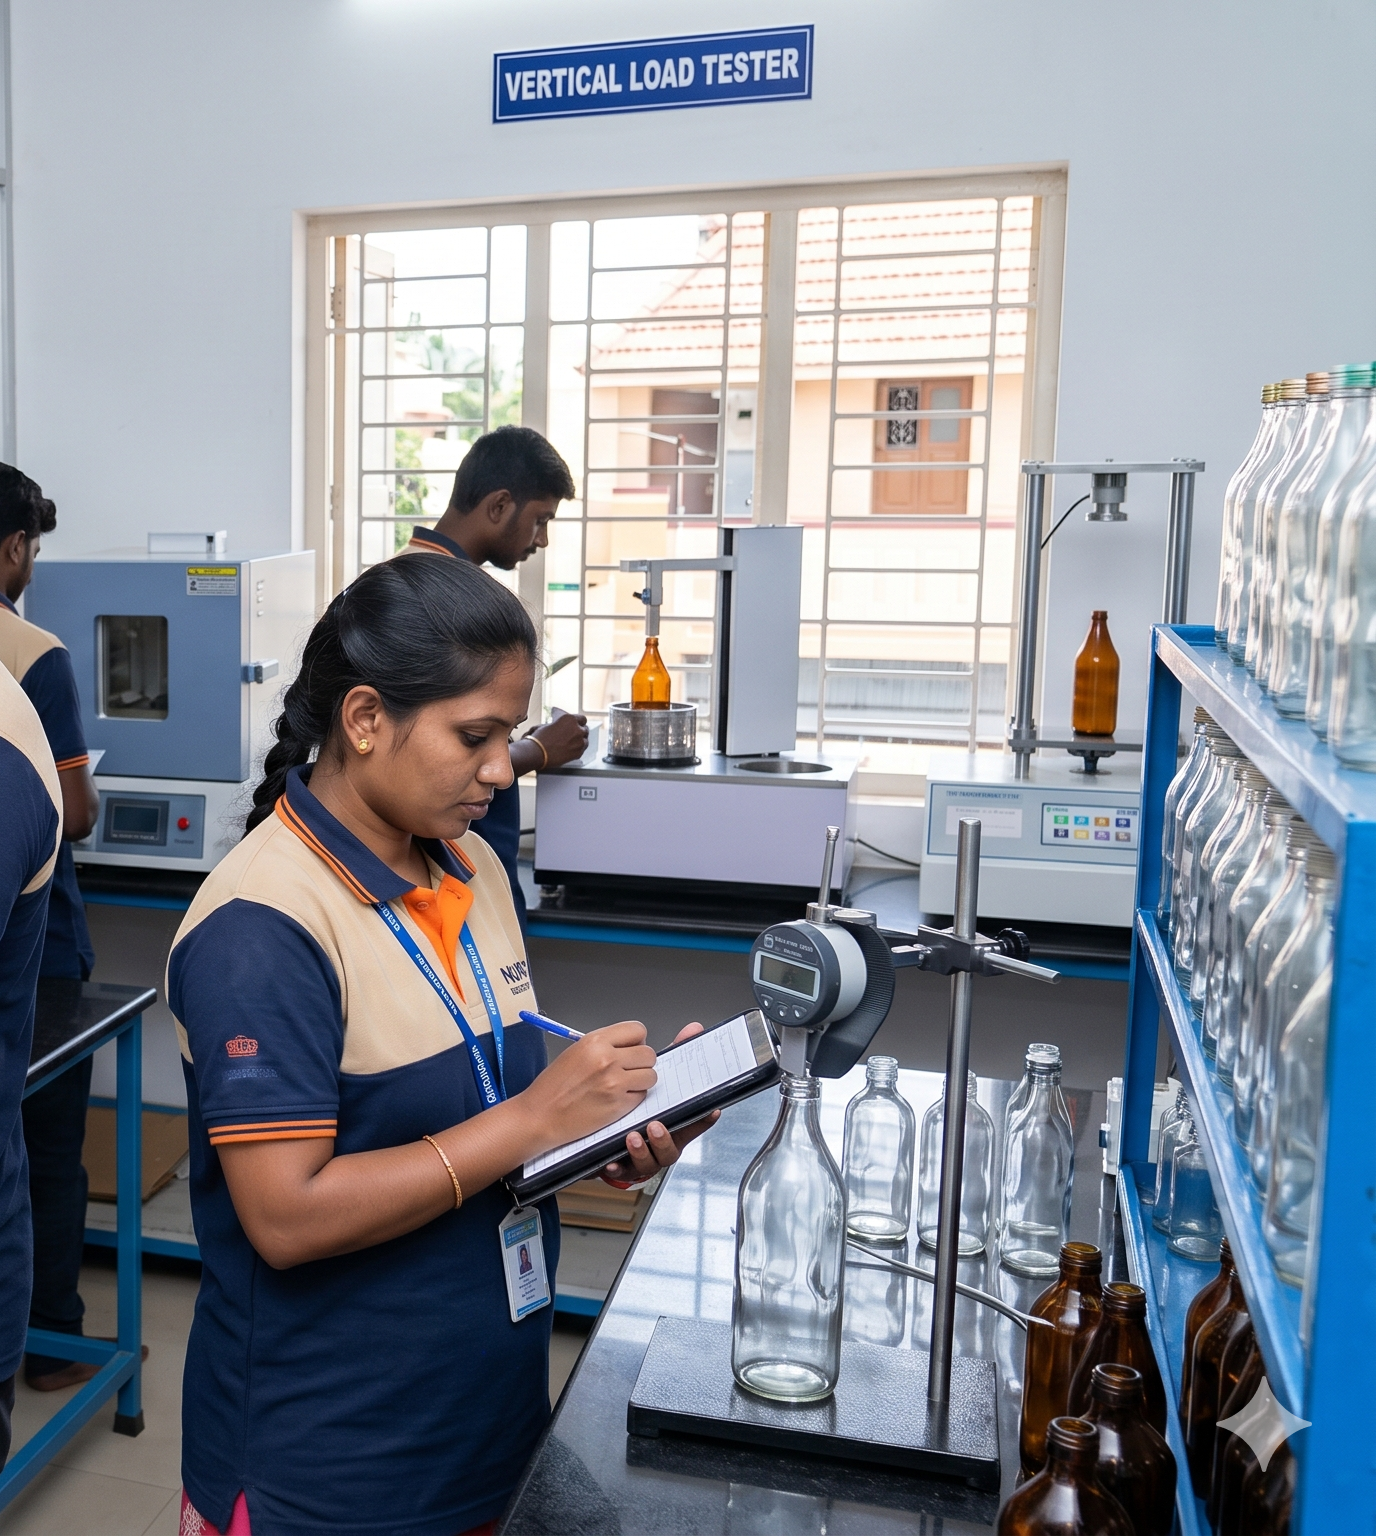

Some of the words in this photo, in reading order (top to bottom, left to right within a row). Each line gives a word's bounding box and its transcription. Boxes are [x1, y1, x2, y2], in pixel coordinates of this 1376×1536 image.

[504, 63, 622, 101] VERTICAL
[629, 57, 695, 92] LOAD
[701, 47, 799, 85] TESTER
